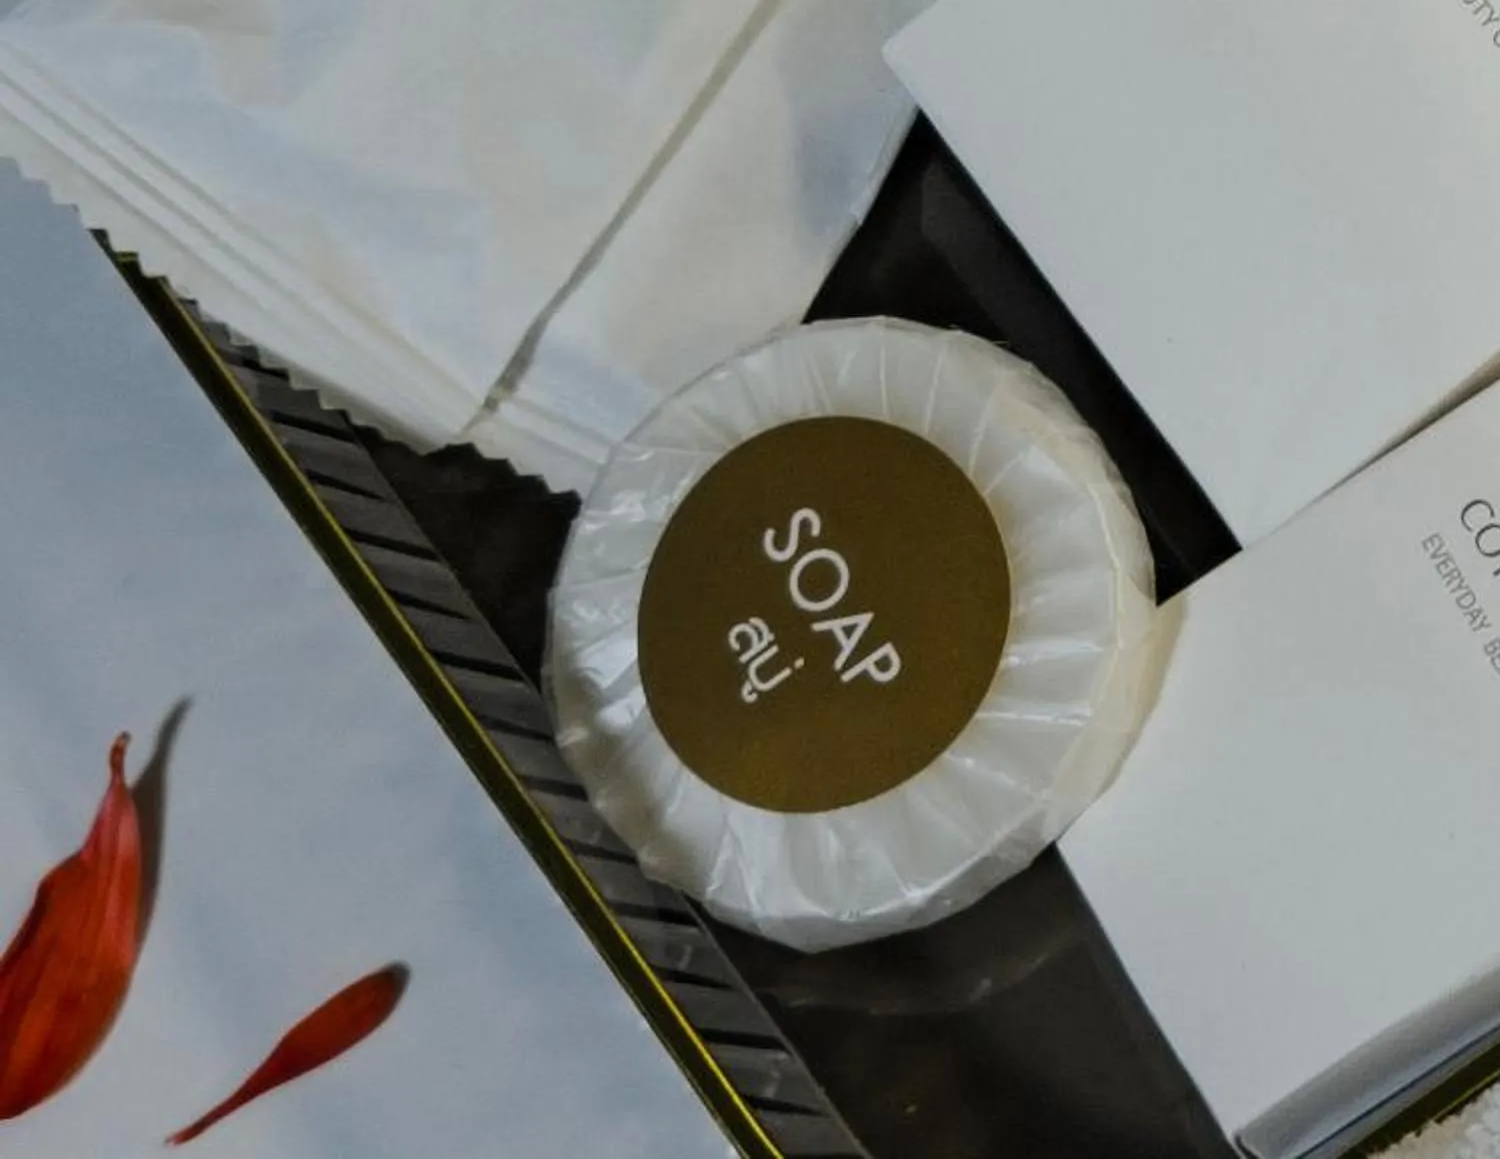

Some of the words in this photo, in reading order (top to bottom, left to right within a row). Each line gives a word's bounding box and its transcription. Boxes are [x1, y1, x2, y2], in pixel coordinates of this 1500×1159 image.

[763, 507, 902, 683] SOAP
[1421, 533, 1492, 633] EVERYDAY
[727, 616, 804, 704] สบู่
